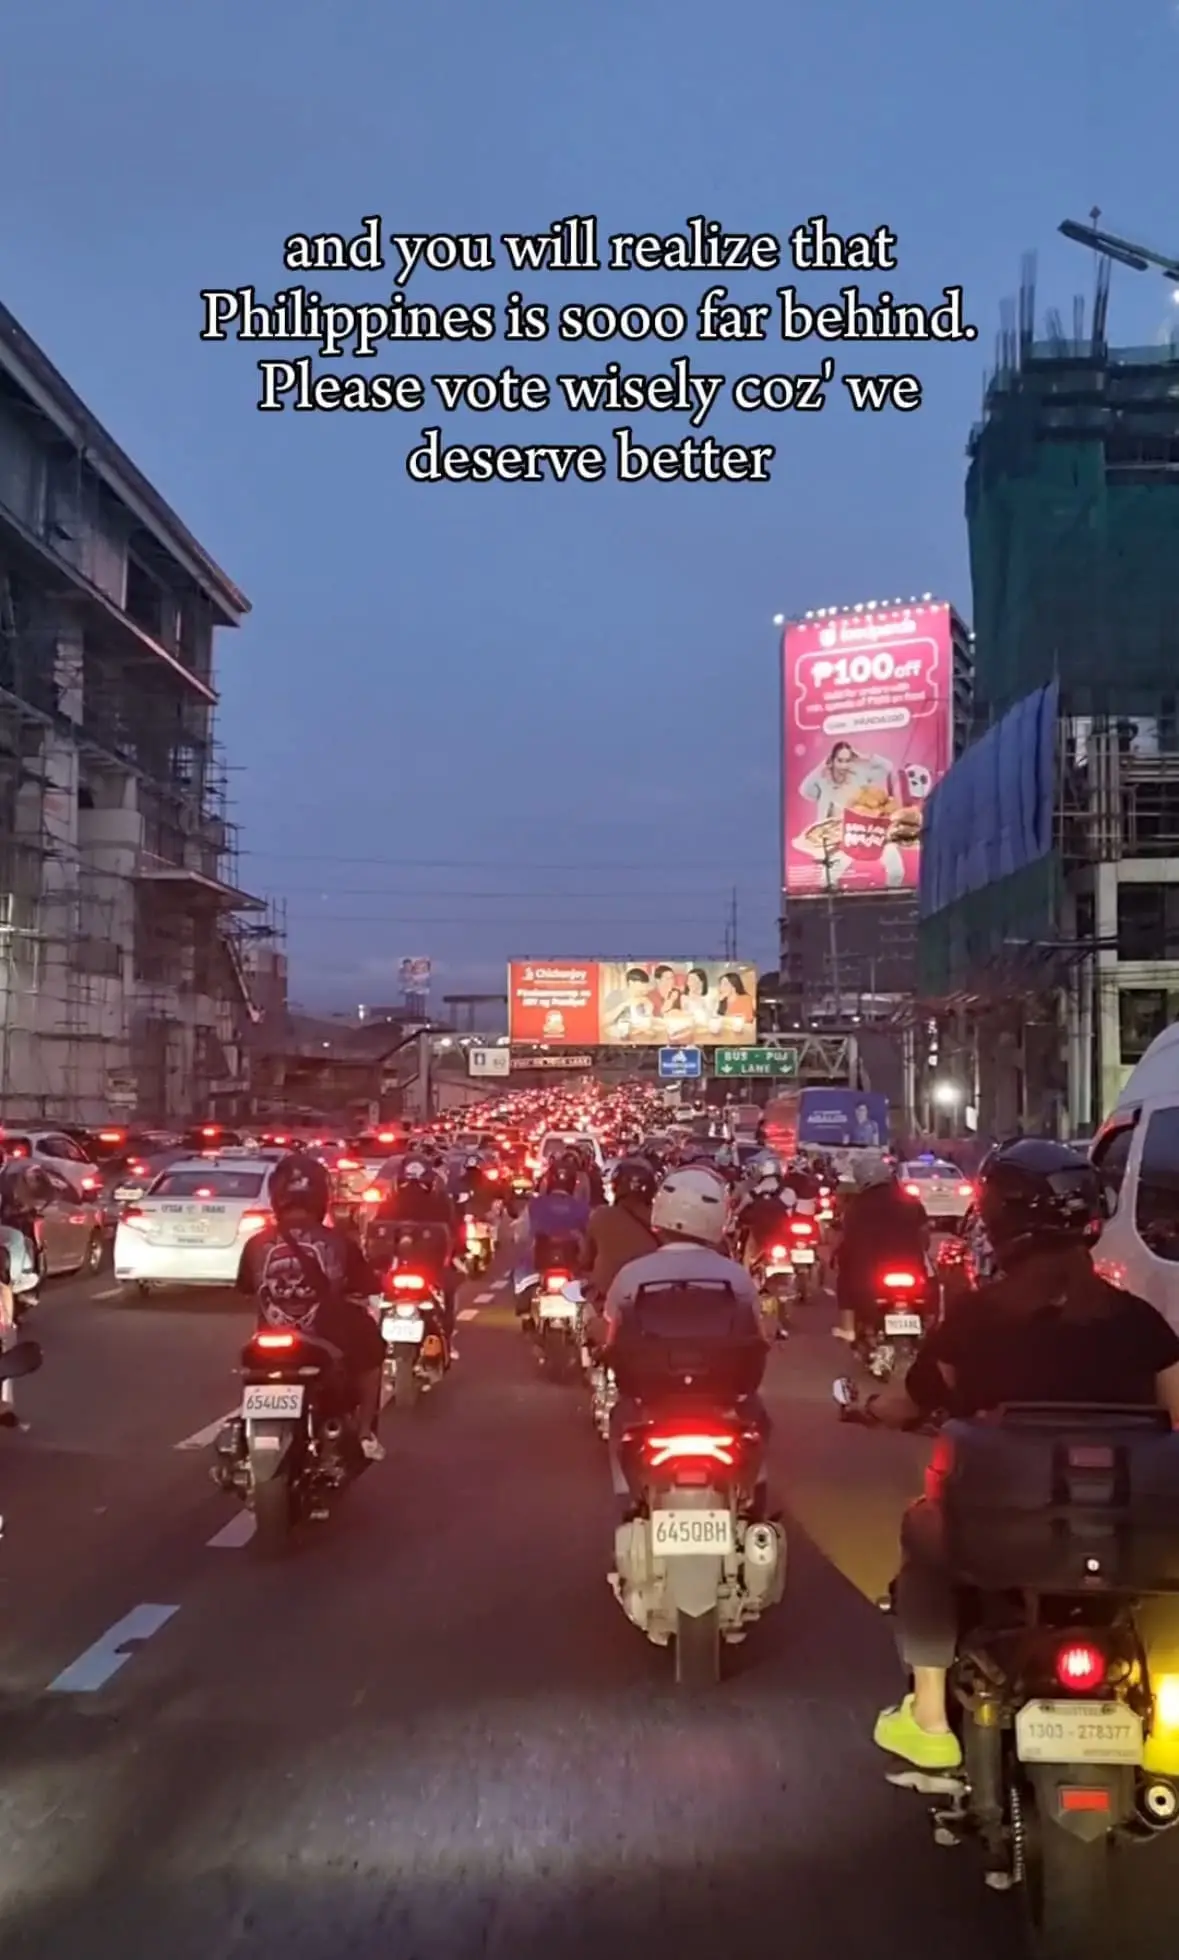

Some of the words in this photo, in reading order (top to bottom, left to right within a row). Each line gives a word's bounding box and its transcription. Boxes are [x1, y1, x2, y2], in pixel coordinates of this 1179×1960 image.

[724, 1051, 748, 1061] BUS
[766, 1051, 788, 1061] PUJ
[741, 1064, 771, 1073] LANE
[246, 1394, 299, 1410] 654USS
